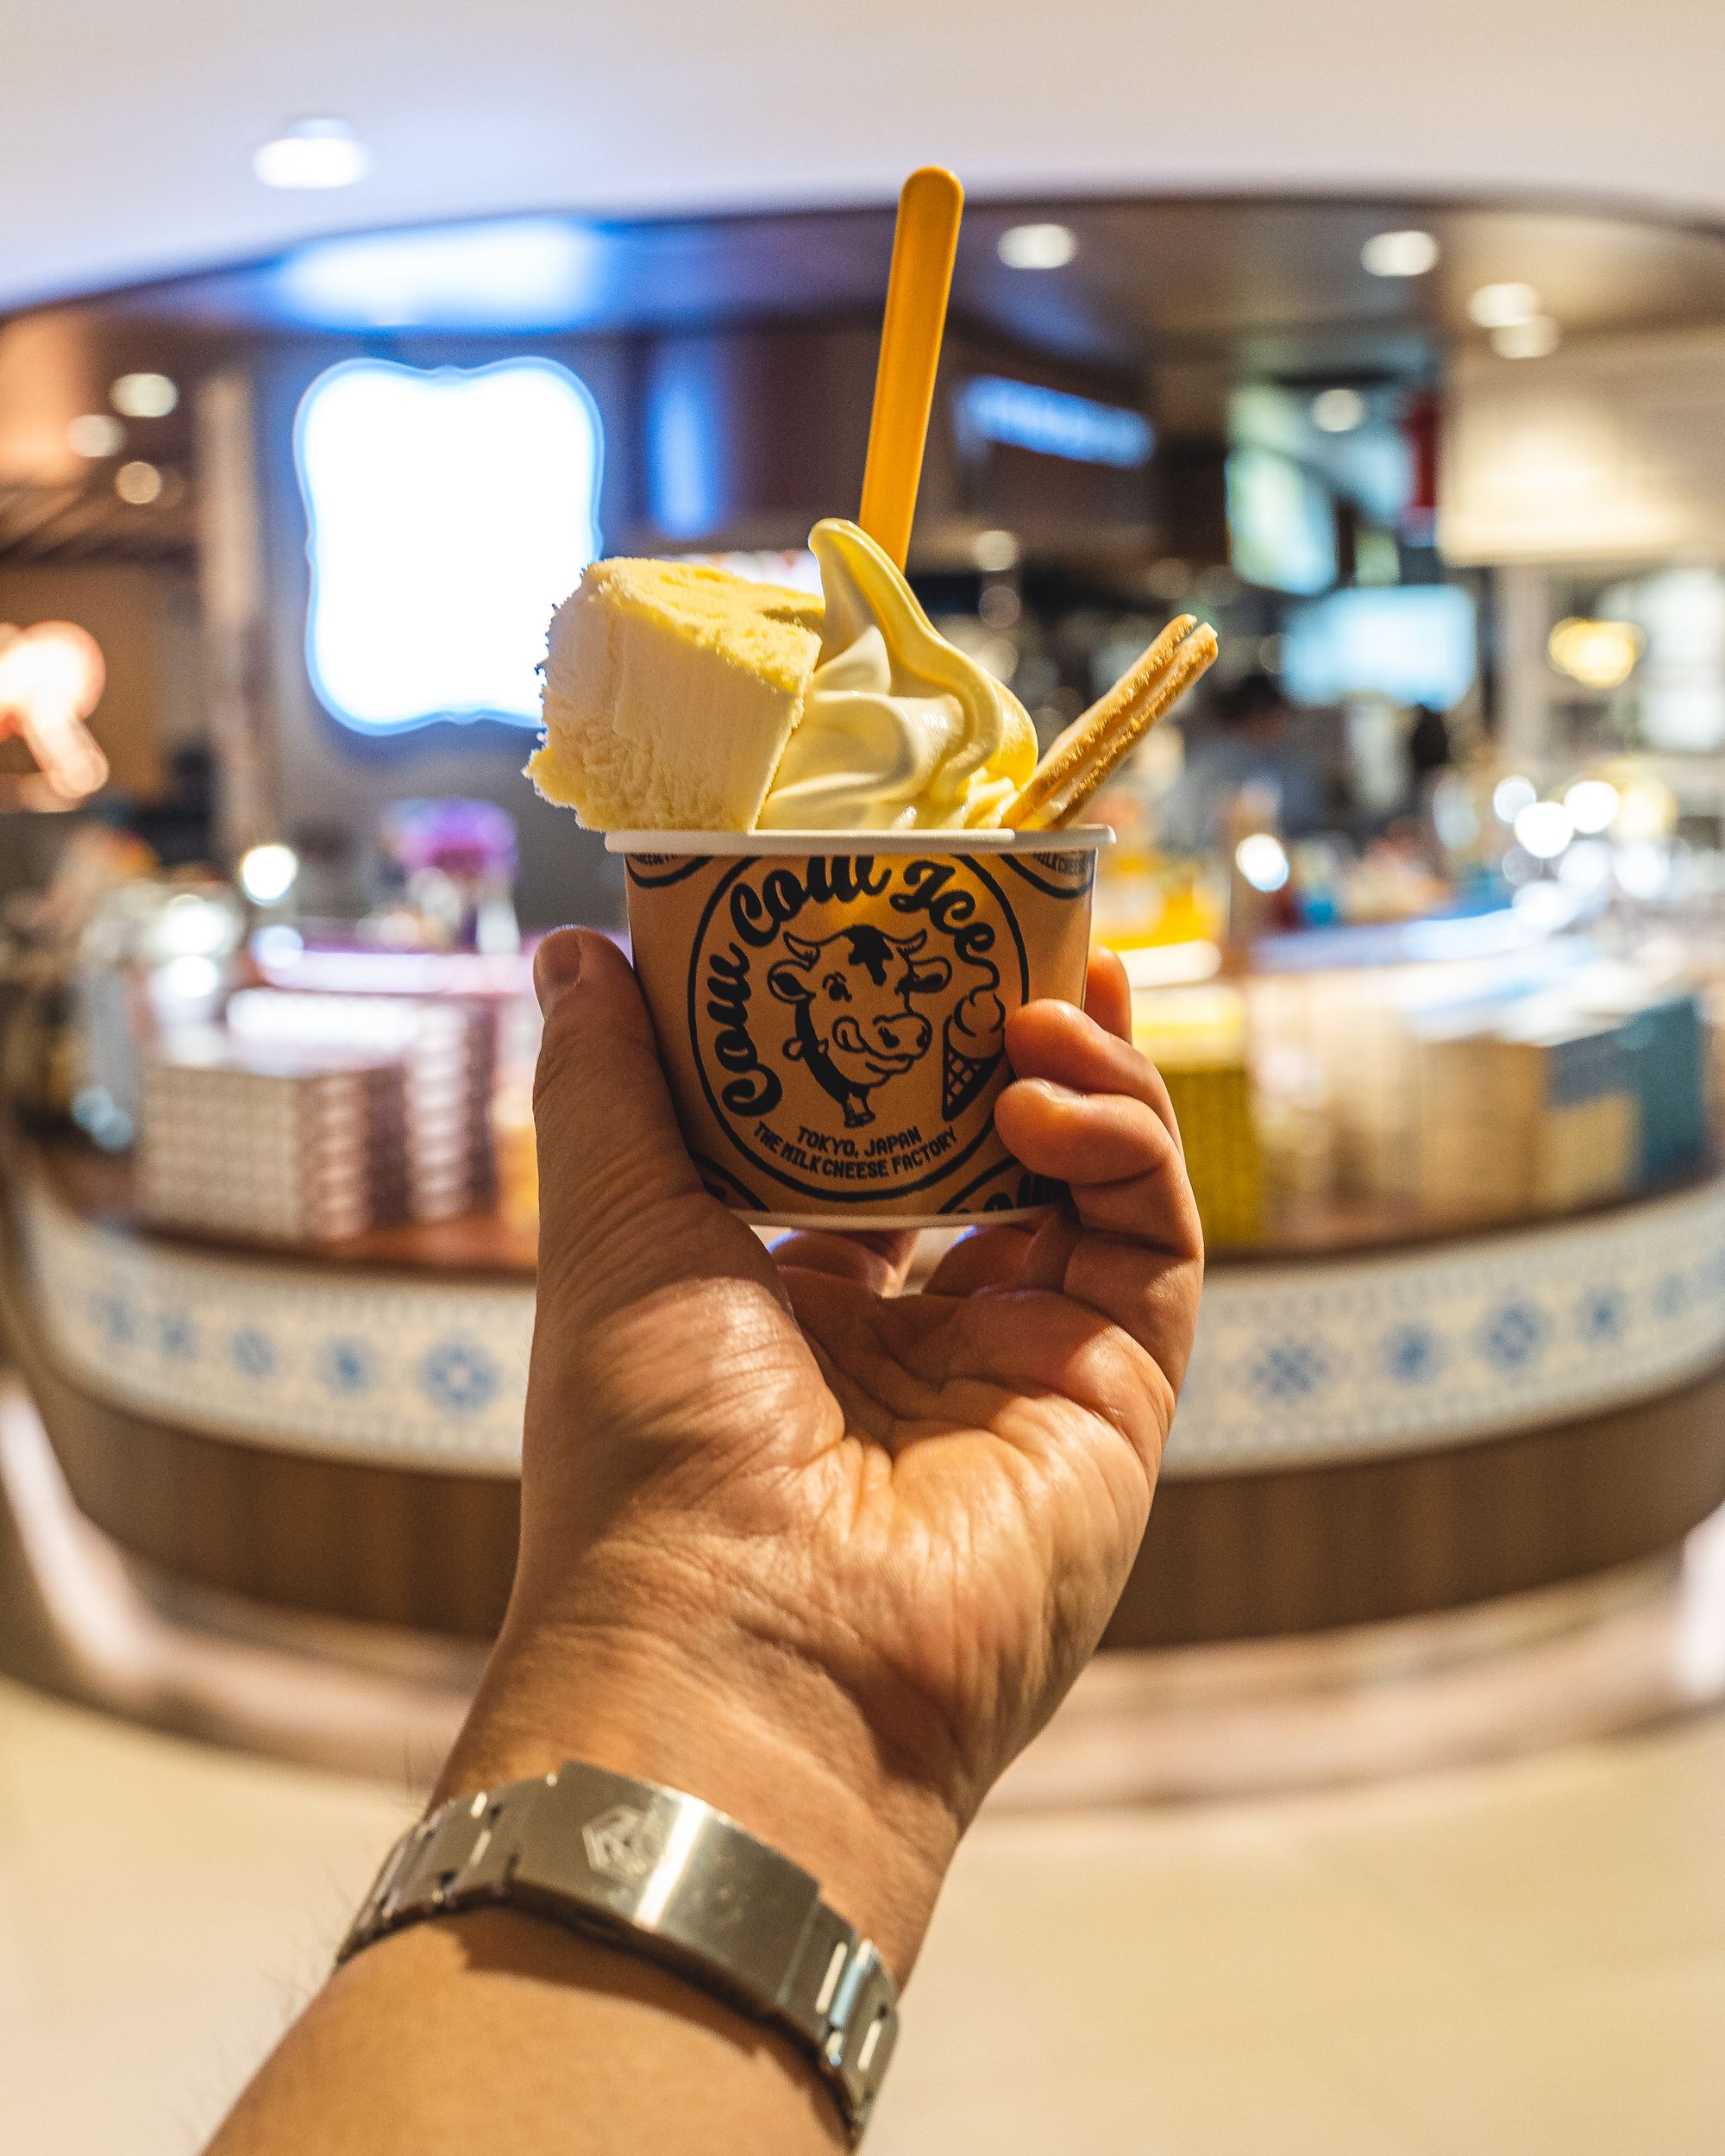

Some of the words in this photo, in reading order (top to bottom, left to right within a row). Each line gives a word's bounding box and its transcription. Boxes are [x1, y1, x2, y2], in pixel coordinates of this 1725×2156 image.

[730, 855, 892, 947] Cow
[889, 860, 1000, 970] Ice
[706, 942, 783, 1117] Cow
[753, 1119, 783, 1154] THE
[780, 1142, 822, 1175] MILK
[821, 1158, 890, 1180] CHEESE
[891, 1125, 958, 1175] FACTORY
[797, 1125, 860, 1159] TOKYO,
[864, 1125, 923, 1157] JAPAN
